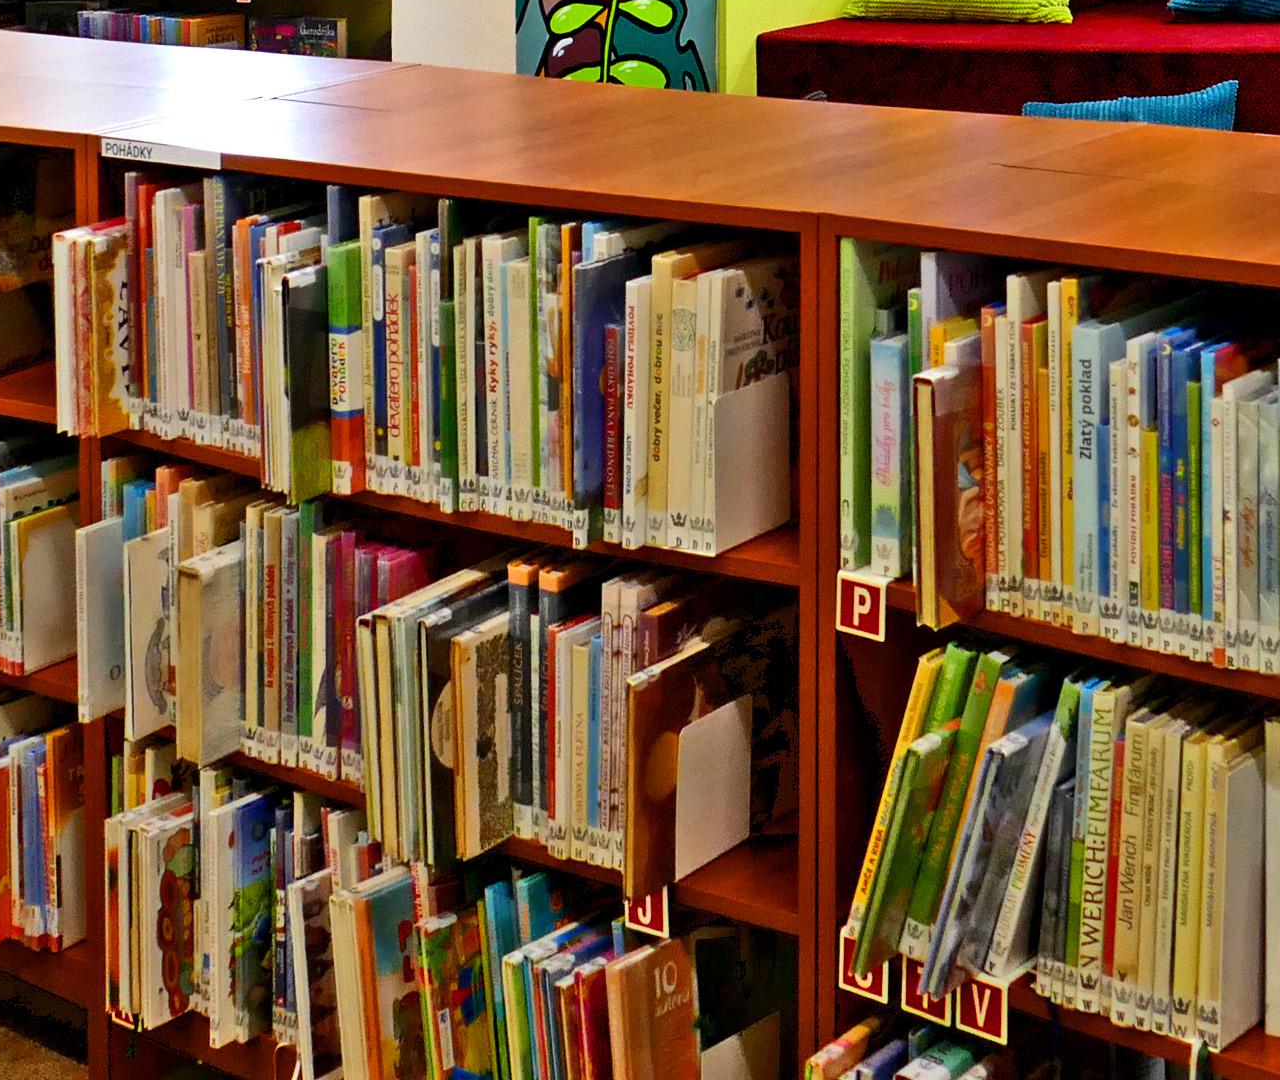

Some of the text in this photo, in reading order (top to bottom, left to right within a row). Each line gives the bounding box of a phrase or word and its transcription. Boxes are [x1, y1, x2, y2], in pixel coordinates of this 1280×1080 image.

[105, 142, 153, 159] POHÁDKY
[485, 286, 496, 317] dobrý
[487, 321, 498, 355] ryky,
[626, 305, 635, 409] POVÍDEJ POHÁDKU
[387, 293, 403, 438] devatero pohádek
[487, 360, 499, 393] Kyky
[653, 313, 663, 424] večer, dobrou noc
[876, 379, 895, 408] holky
[996, 387, 1005, 432] ZOUBEK
[1009, 393, 1017, 431] POHÁDKY
[1078, 358, 1094, 460] Zlatý poklad
[881, 411, 893, 432] pro
[490, 439, 499, 480] MICHAL
[1129, 474, 1137, 565] POVÍDEJ POHÁDKU
[266, 564, 275, 599] pohádek
[285, 598, 295, 633] pohádek
[853, 584, 872, 626] P
[1118, 733, 1143, 930] Jan Werich Fimfárum
[1081, 838, 1105, 946] WERICH:
[653, 961, 678, 999] 10
[972, 987, 992, 1028] V
